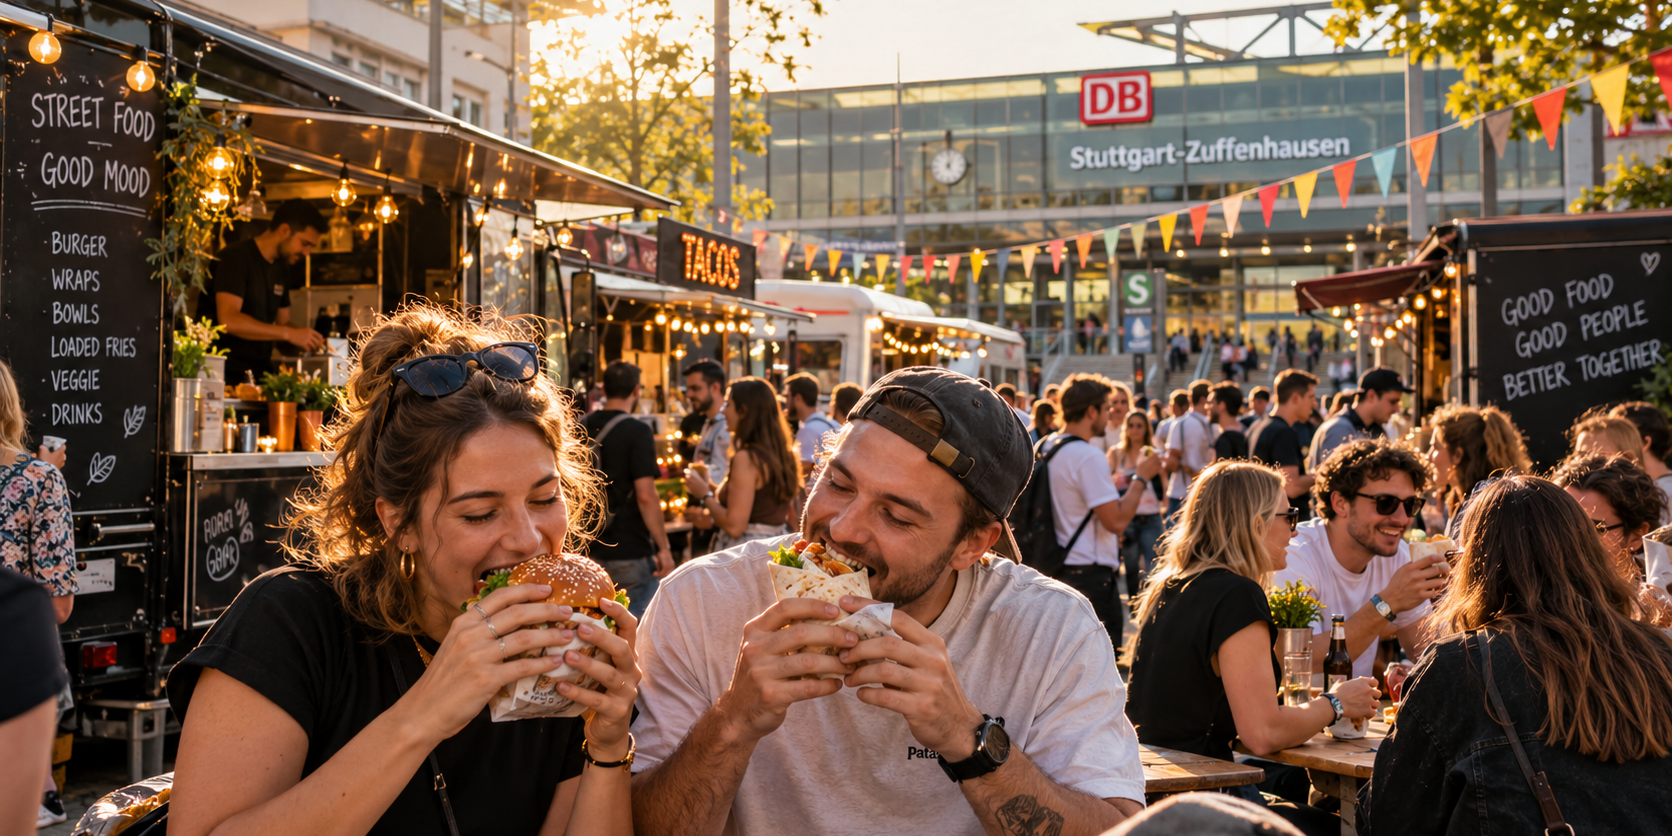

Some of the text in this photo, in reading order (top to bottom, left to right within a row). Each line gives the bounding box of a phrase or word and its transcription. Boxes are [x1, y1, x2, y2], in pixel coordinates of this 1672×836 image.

[1089, 80, 1142, 115] DB
[31, 92, 156, 142] STREET FOOD
[1069, 135, 1350, 172] Stuttgart-Zuffenhausen
[41, 152, 150, 198] GOOD MOOD
[51, 231, 108, 258] BURGER
[681, 232, 740, 290] TACOS
[51, 268, 100, 292] WRAPS
[1128, 274, 1149, 305] S
[52, 301, 100, 325] BOWLS
[1501, 273, 1614, 327] GOOD FOOD
[1515, 299, 1649, 358] GOOD PEOPLE
[51, 336, 137, 358] LOADED FRIES
[51, 369, 100, 391] VEGGIE
[1502, 338, 1666, 401] BETTER TOGETHER
[51, 402, 103, 426] DRINKS
[907, 746, 939, 760] Pata
